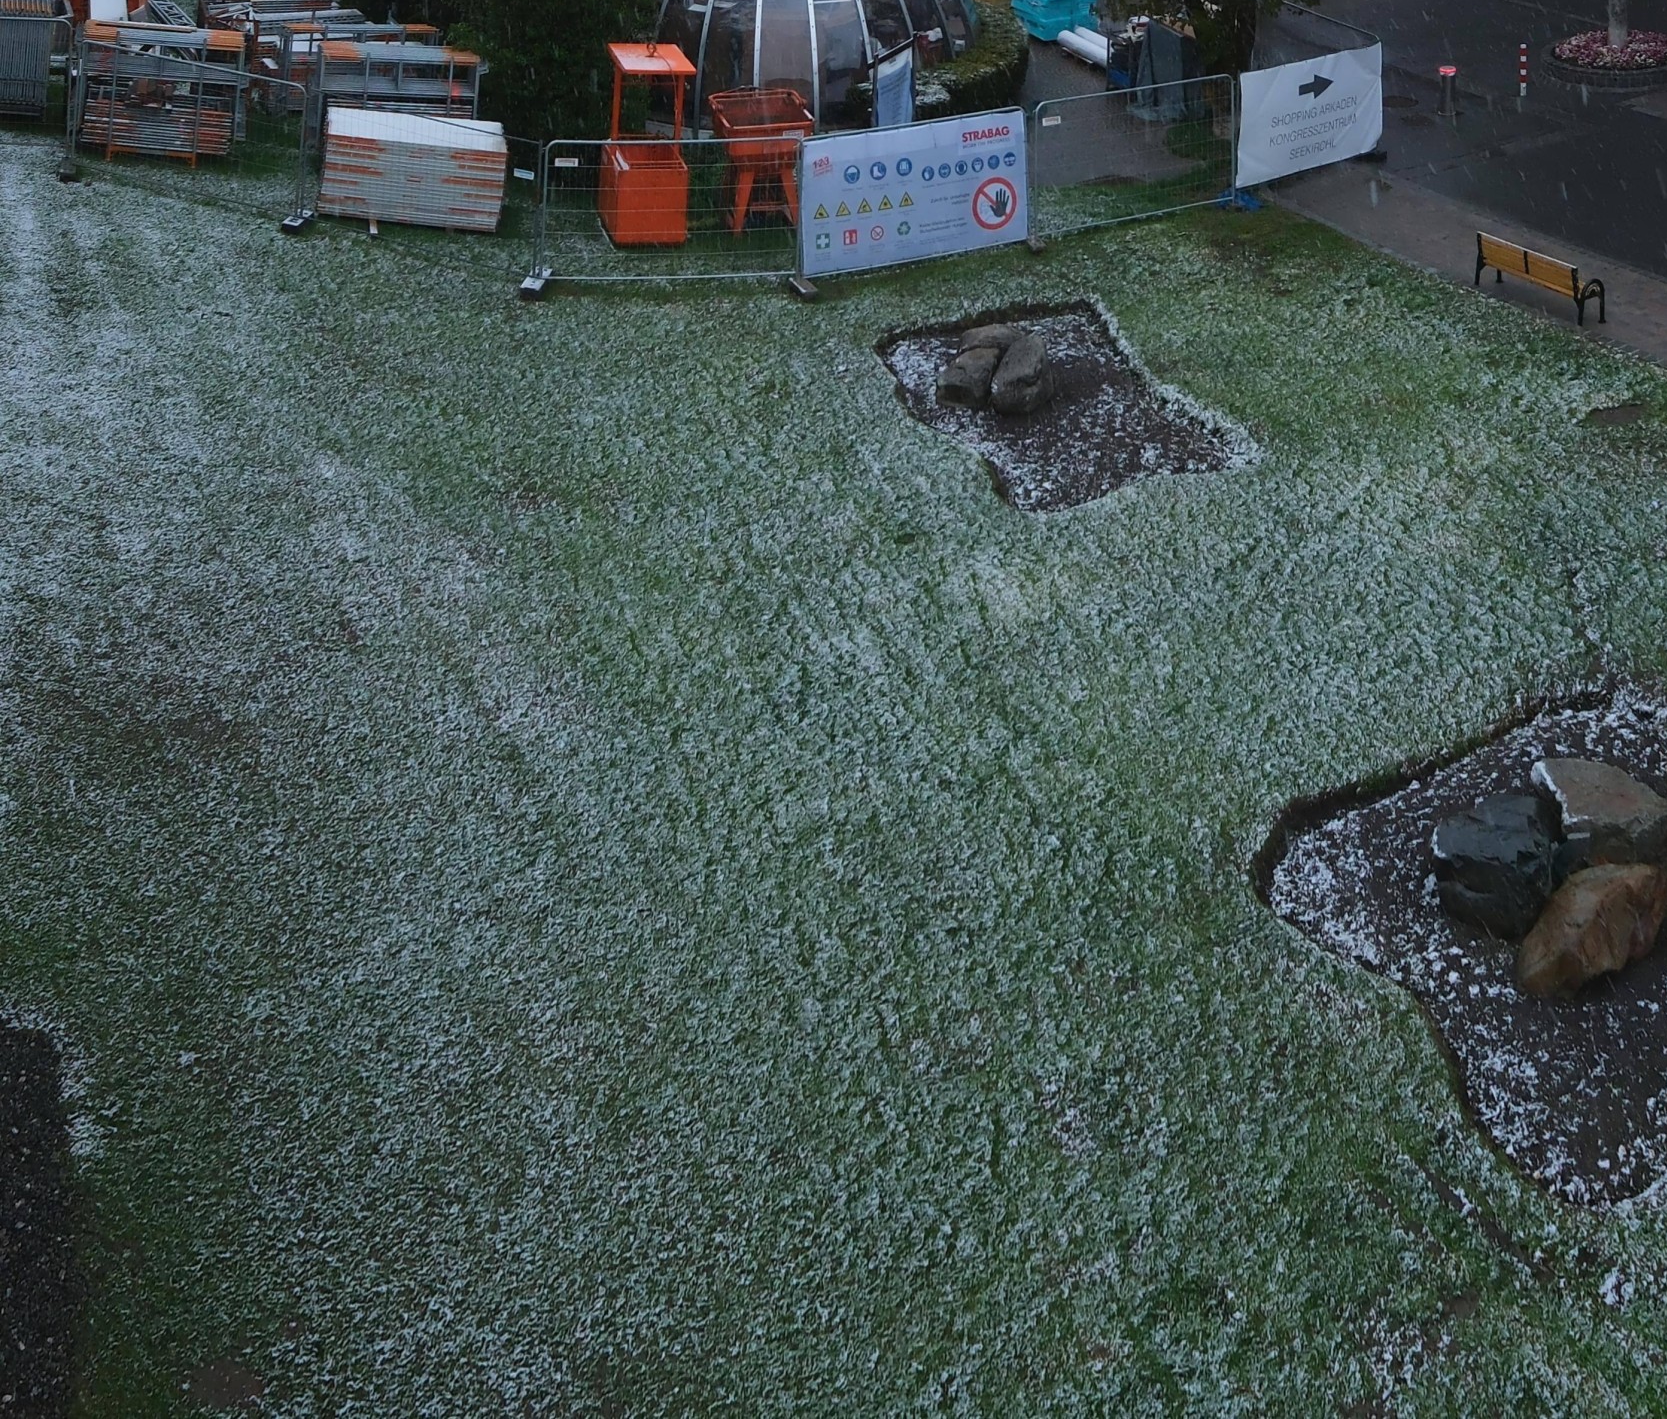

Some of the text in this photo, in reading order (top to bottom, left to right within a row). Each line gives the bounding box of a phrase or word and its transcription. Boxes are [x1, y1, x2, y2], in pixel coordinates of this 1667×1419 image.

[1271, 95, 1358, 129] SHOPPING ARKADEN
[962, 126, 1010, 143] STRABAG
[1269, 113, 1357, 148] KONGRESSZENTRUM
[1289, 140, 1337, 160] SEEKIRCHL
